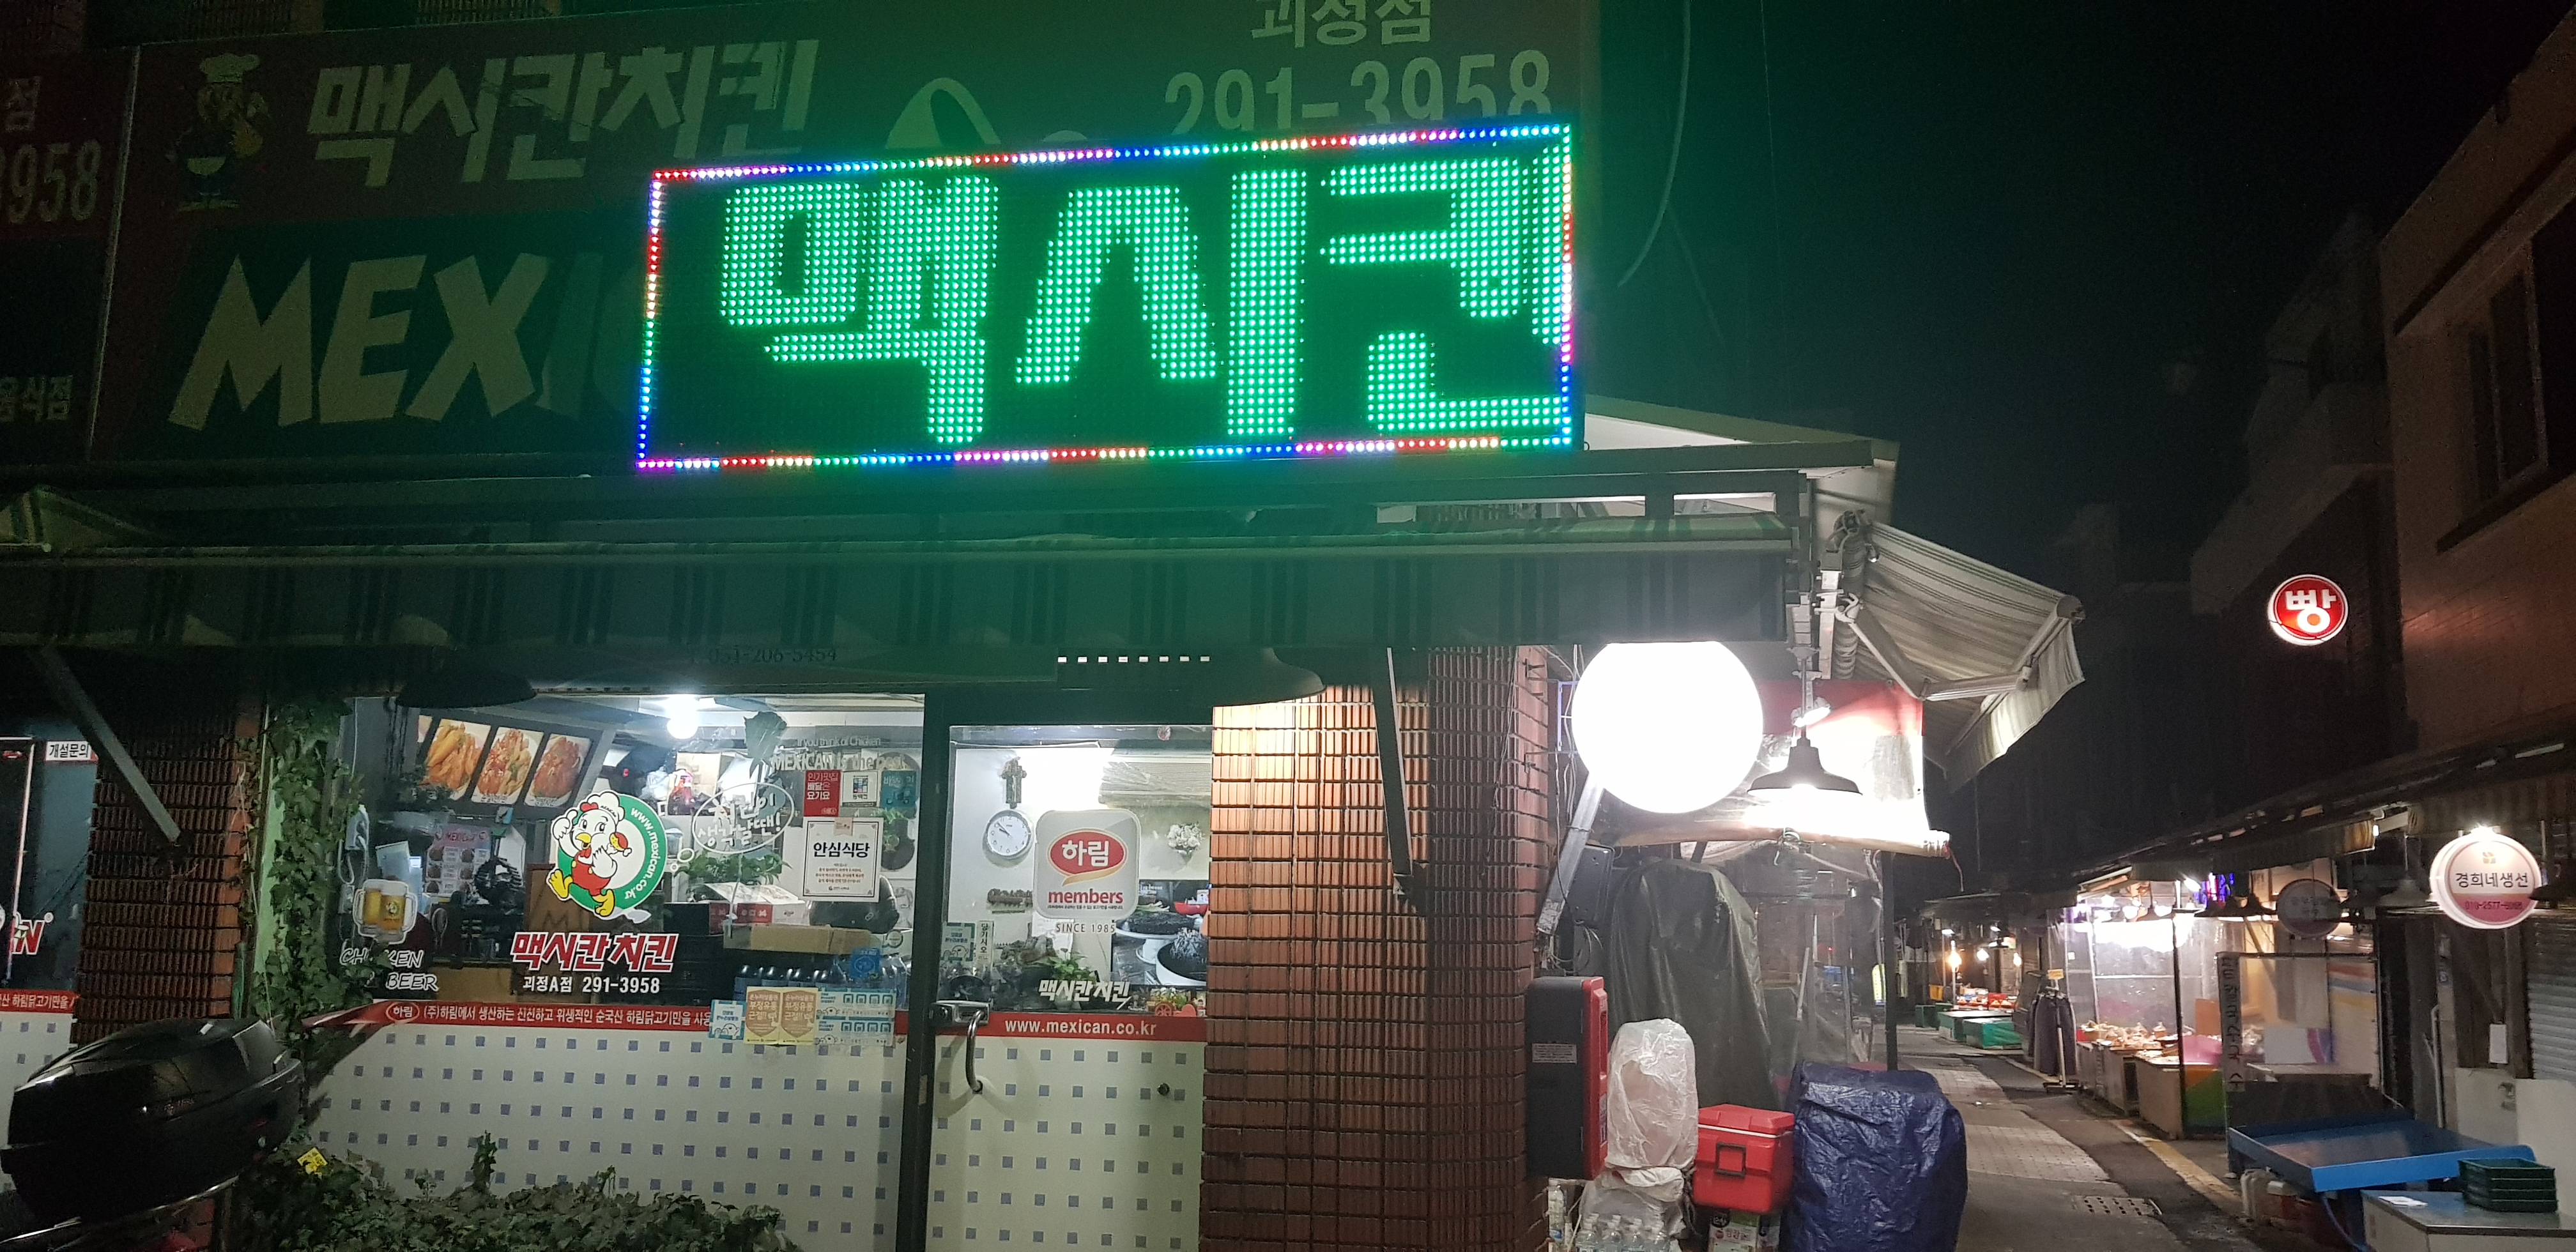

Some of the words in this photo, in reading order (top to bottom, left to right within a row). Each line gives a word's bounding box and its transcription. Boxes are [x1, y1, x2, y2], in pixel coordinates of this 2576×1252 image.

[1164, 50, 1551, 139] 291-3958
[307, 40, 820, 187] 맥시칸치킨
[0, 139, 102, 225] 958
[2285, 589, 2338, 634] 빵
[49, 742, 89, 759] 개설문의
[772, 752, 835, 771] MEXICAN
[836, 752, 847, 769] is
[852, 751, 874, 770] the
[807, 782, 831, 791] 배달은
[808, 772, 839, 781] 인기맛집
[806, 791, 831, 800] 요기요
[624, 807, 661, 899] www.mexican.co.kr
[813, 841, 871, 858] 안심식당
[1061, 839, 1110, 867] 하림
[2455, 872, 2529, 889] 경희네생선
[1048, 888, 1124, 904] members
[980, 922, 990, 954] 당기시오
[1056, 923, 1085, 933] SINCE
[1091, 923, 1116, 933] 1985
[339, 947, 424, 968] CHKEN
[510, 931, 679, 972] 맥시칸치킨
[385, 972, 440, 992] BEER
[523, 976, 572, 993] 괴정A점
[582, 977, 660, 994] 291-3958
[1038, 979, 1131, 1003] 맥시칸치킨
[393, 1005, 413, 1018] 하림
[423, 1005, 475, 1020] (주)하림에서
[479, 1007, 514, 1021] 생산하는
[556, 1007, 593, 1023] 위생적인
[595, 1009, 624, 1024] 순국산
[626, 1010, 691, 1026] 하림닭고기만을
[749, 1001, 778, 1011] 부정유통
[785, 1002, 814, 1012] 부정유통
[1005, 1018, 1158, 1035] www.mexican.co.kr
